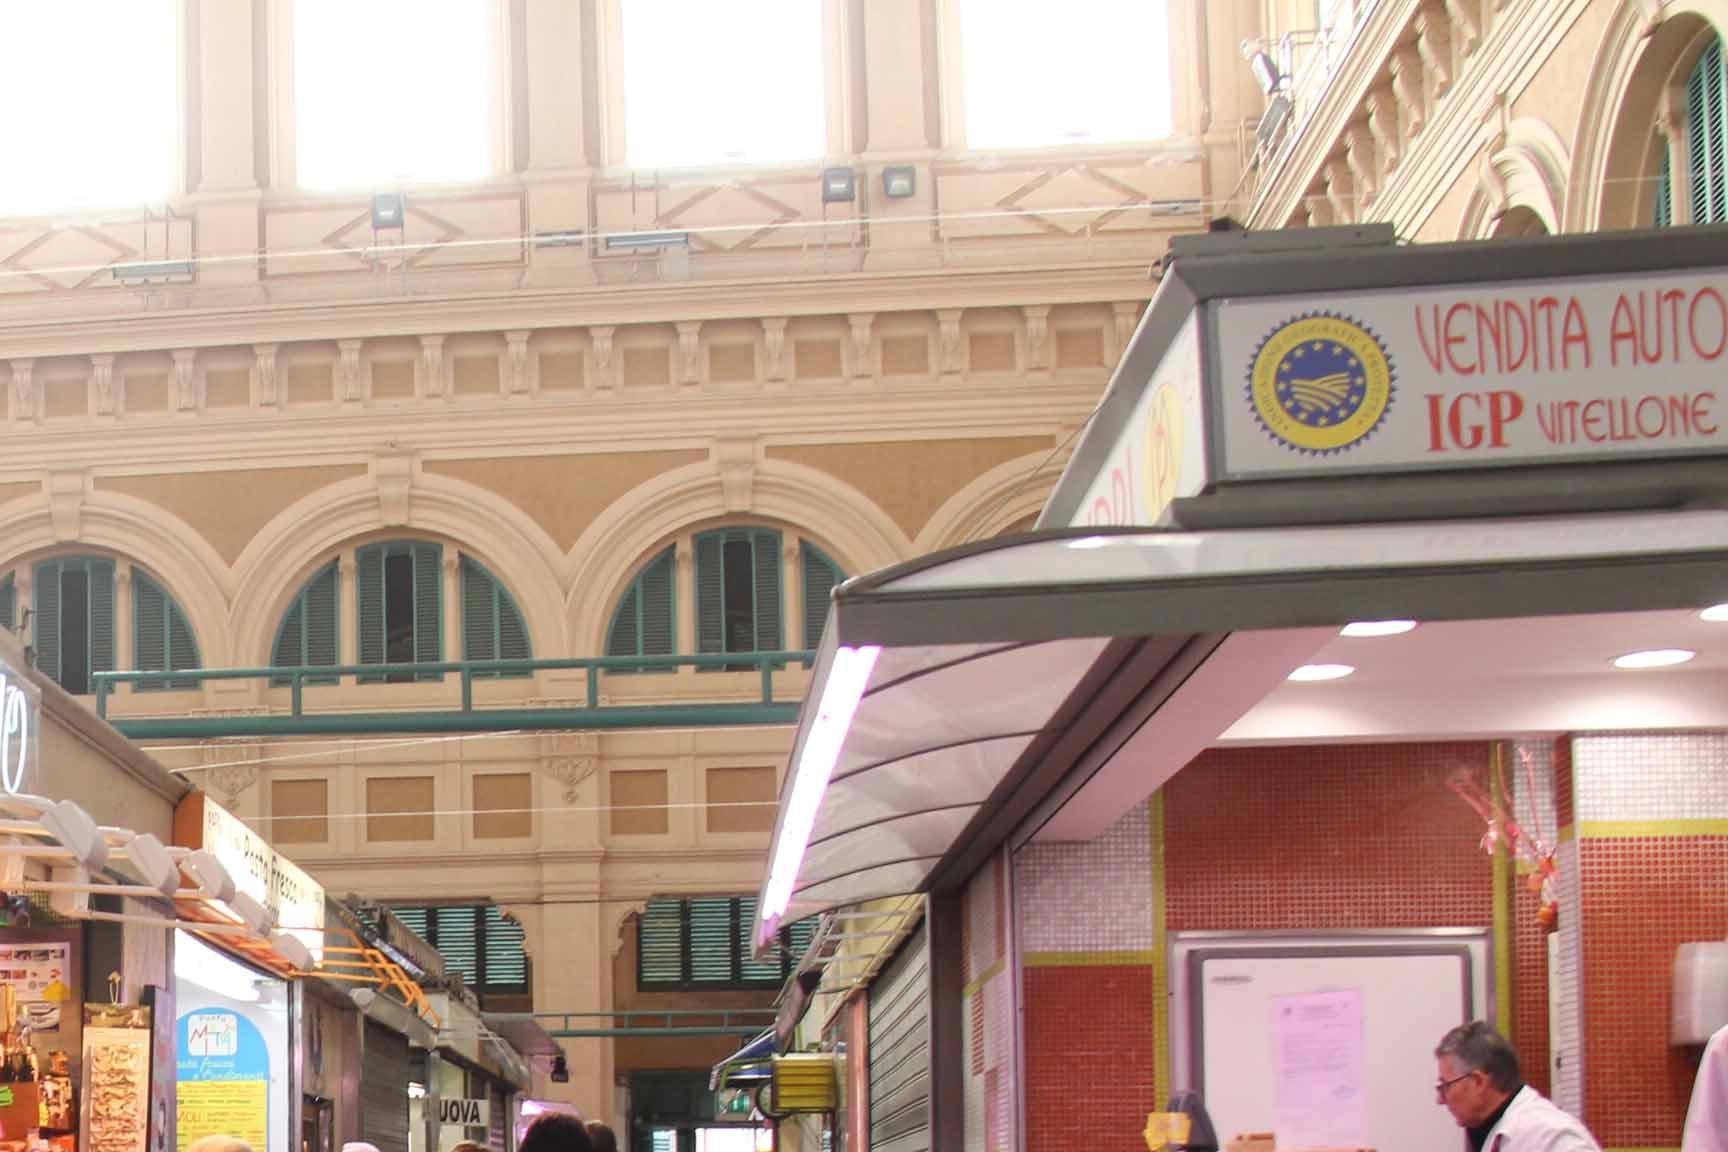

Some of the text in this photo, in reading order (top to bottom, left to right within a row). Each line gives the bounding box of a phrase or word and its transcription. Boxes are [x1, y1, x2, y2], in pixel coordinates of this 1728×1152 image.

[1415, 286, 1728, 375] VENDITA AUTO
[1424, 389, 1720, 452] IGP VITELLONE
